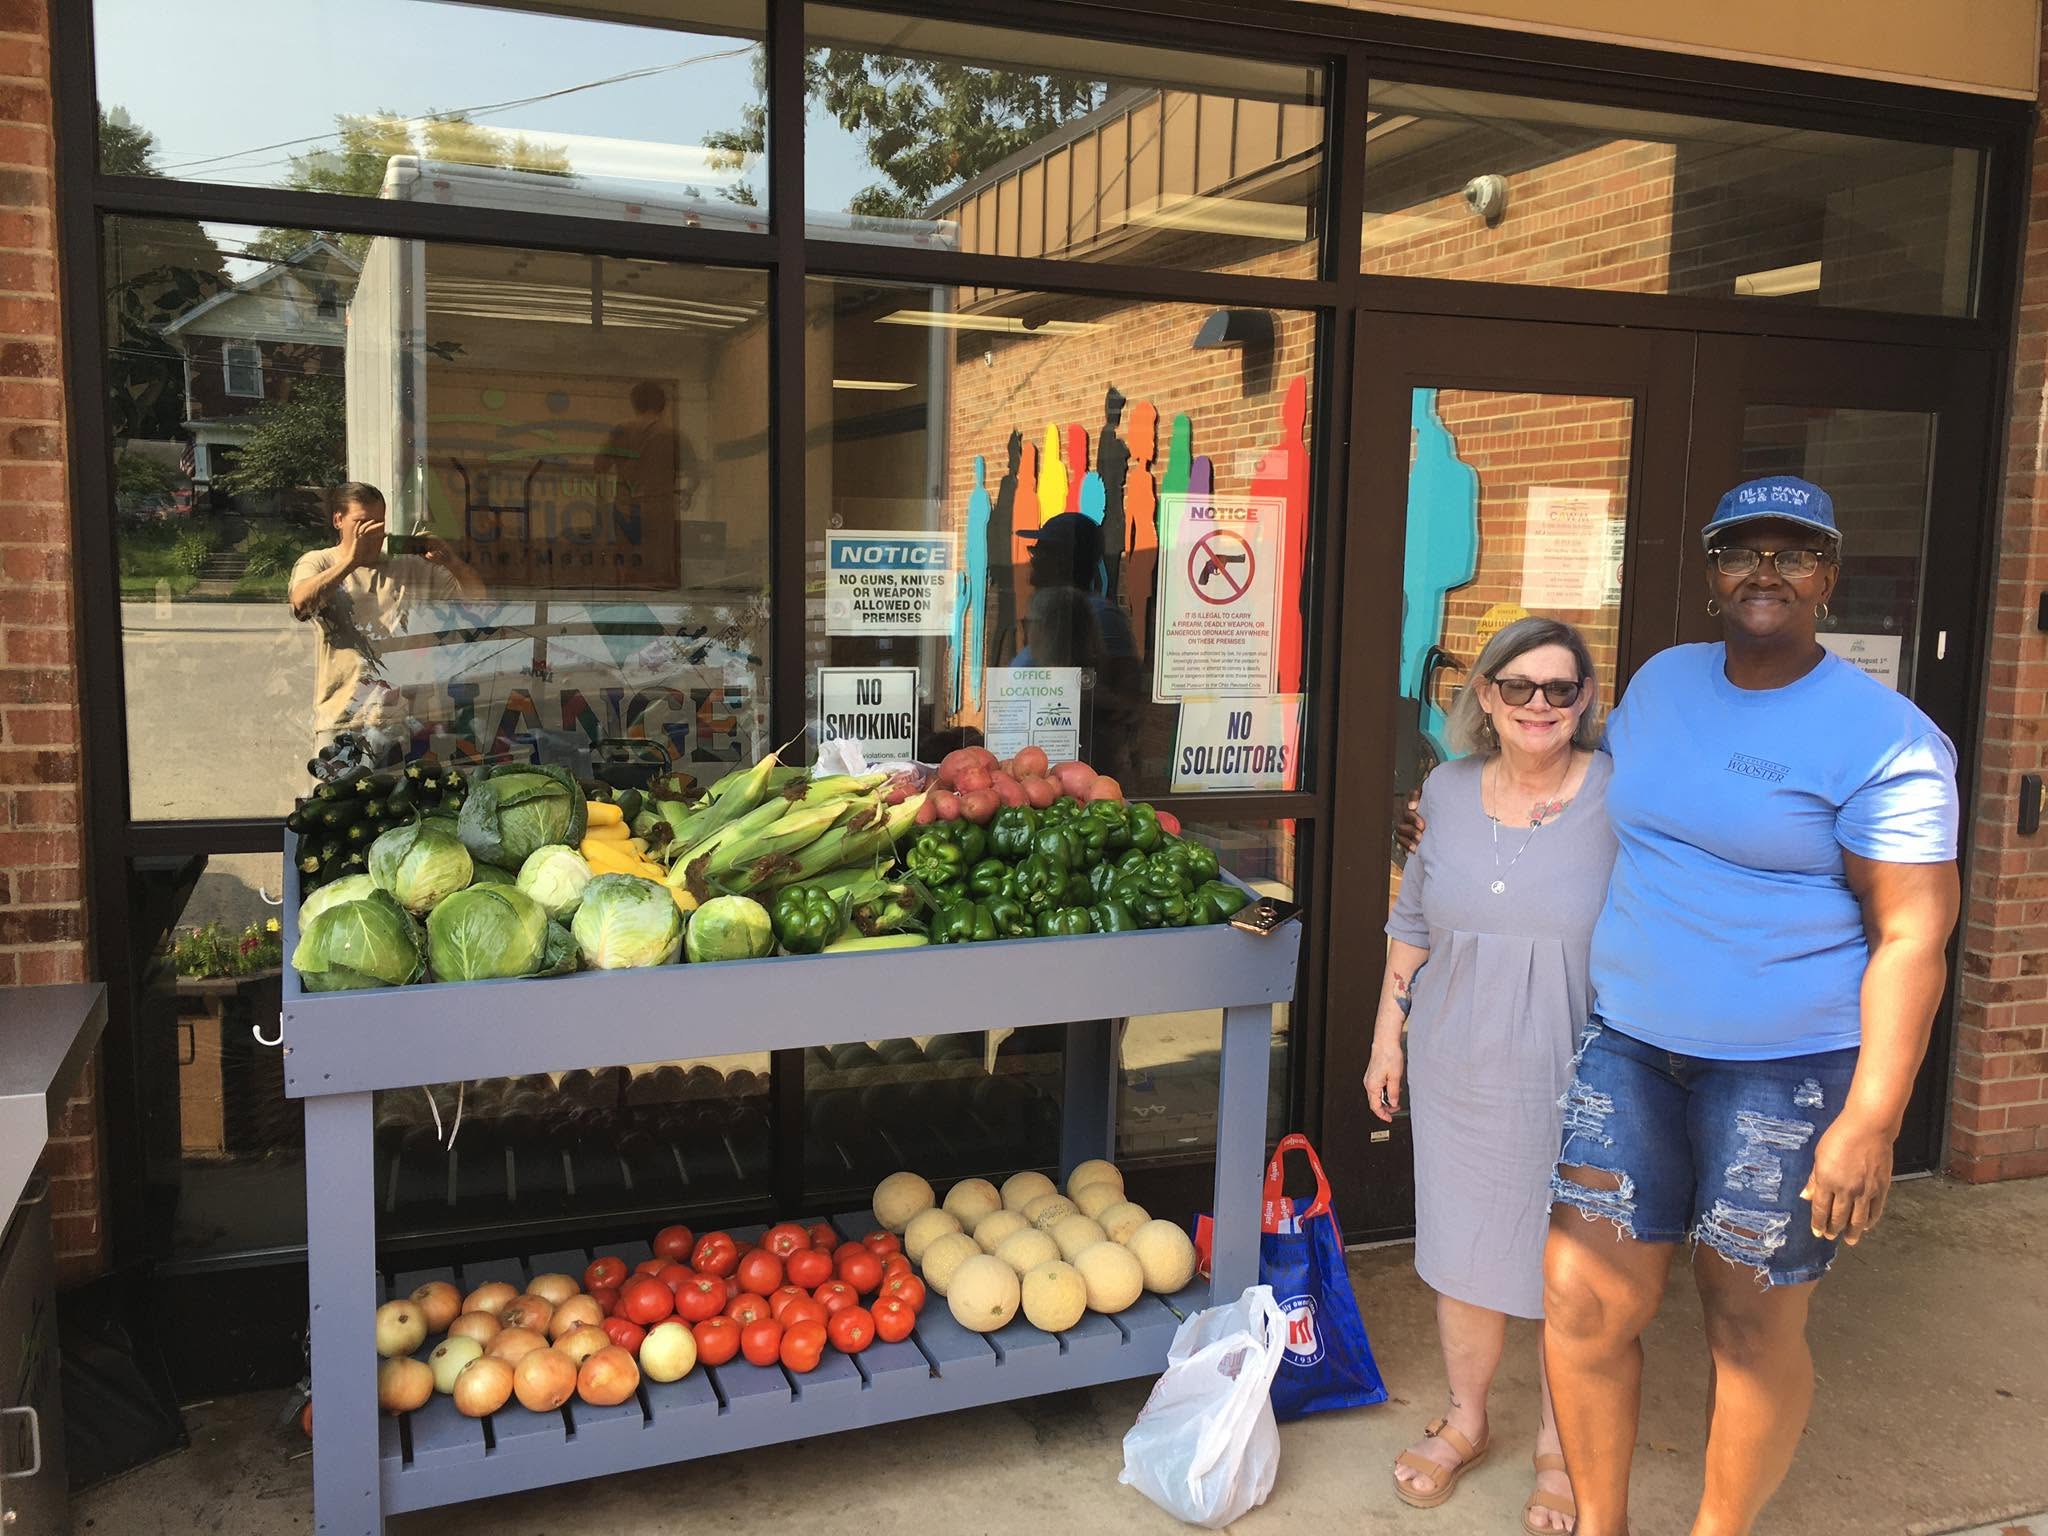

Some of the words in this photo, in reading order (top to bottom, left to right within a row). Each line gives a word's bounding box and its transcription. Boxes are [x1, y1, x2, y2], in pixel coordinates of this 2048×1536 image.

[1772, 486, 1810, 504] NAVY
[1191, 506, 1258, 520] NOTICE
[839, 545, 946, 564] NOTICE
[839, 574, 857, 585] NO
[860, 574, 898, 587] GUNS,
[901, 575, 945, 586] KNIVES
[853, 587, 870, 598] OR
[873, 587, 931, 598] WEAPONS
[853, 600, 910, 611] ALLOWED
[913, 600, 931, 611] ON
[862, 613, 922, 623] PREMISES
[1231, 612, 1251, 620] CARRY
[1235, 629, 1270, 637] ANYWHERE
[1012, 670, 1052, 680] OFFICE
[856, 678, 882, 706] NO
[1000, 686, 1064, 697] LOCATIONS
[825, 711, 911, 741] SMOKING
[1227, 710, 1253, 740] NO
[1181, 744, 1290, 775] SOLICITORS
[1728, 759, 1785, 783] WOOSTER
